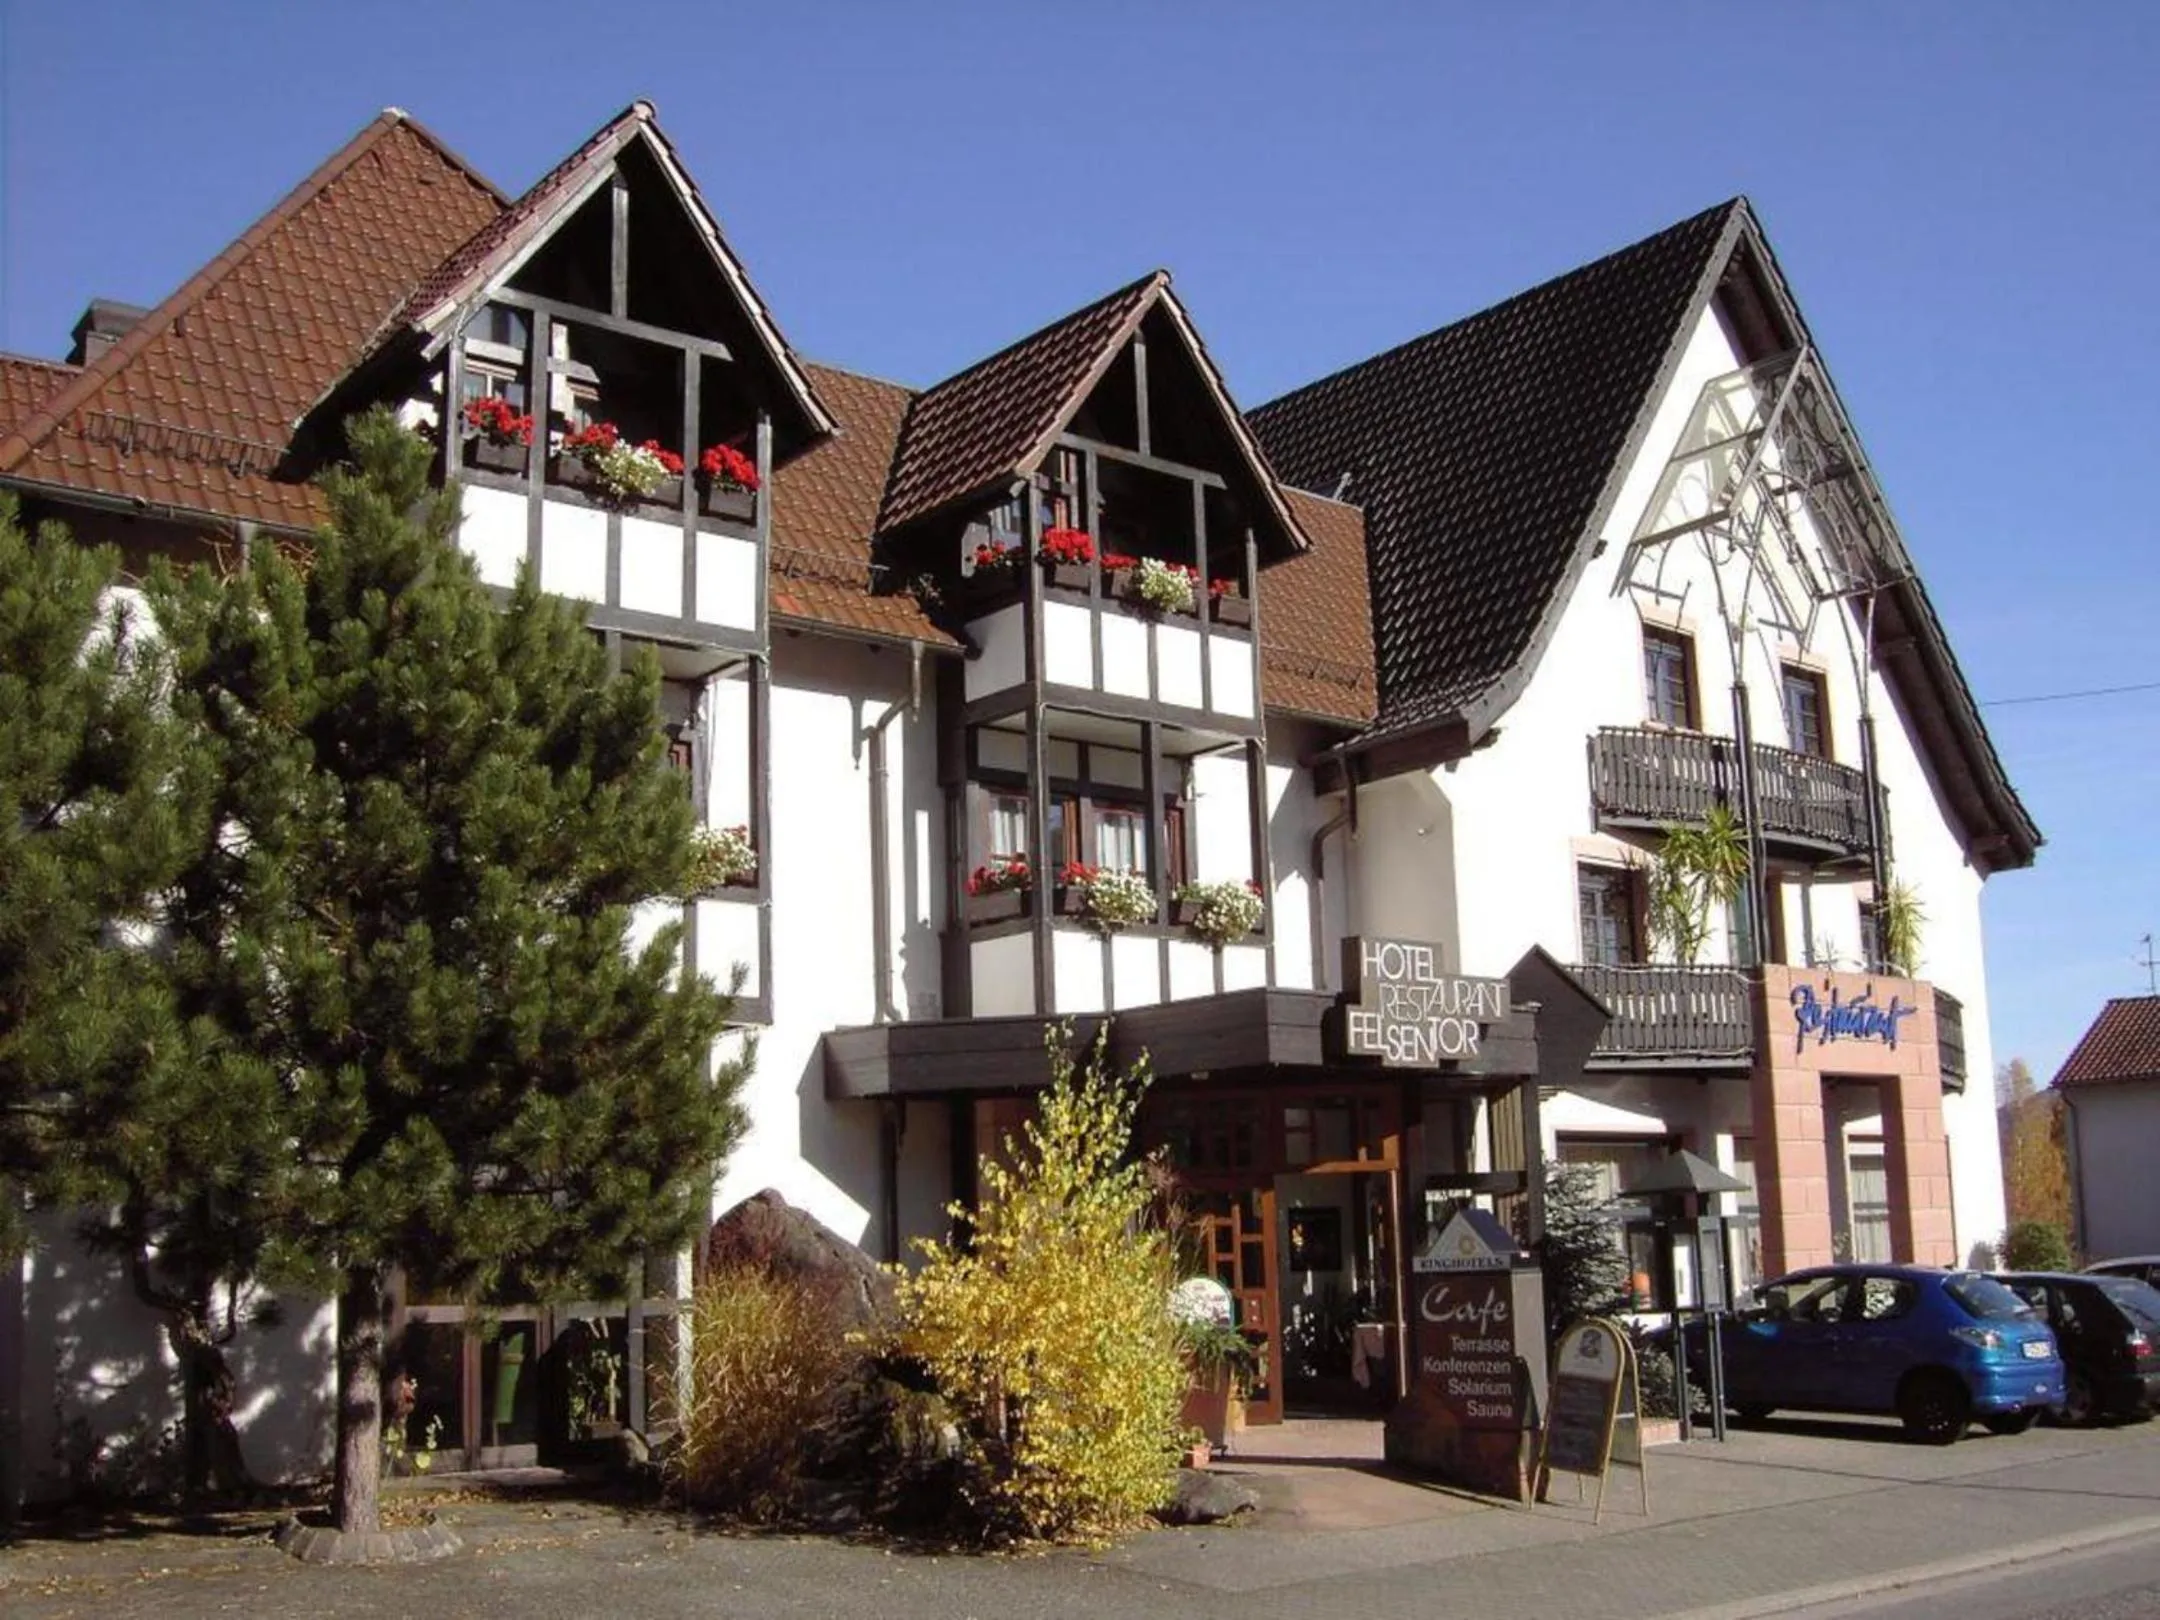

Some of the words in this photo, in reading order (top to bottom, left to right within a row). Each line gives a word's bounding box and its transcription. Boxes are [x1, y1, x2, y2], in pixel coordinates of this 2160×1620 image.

[1361, 939, 1441, 983] HOTEL
[1379, 980, 1506, 1021] RESTAURANT
[1350, 1012, 1479, 1062] FELSENTOR
[1421, 1283, 1508, 1335] Cafe
[1451, 1336, 1510, 1352] Terrasse
[1423, 1356, 1511, 1373] Konferenzen
[1448, 1378, 1512, 1395] Solarium
[1467, 1400, 1512, 1417] Sauna
